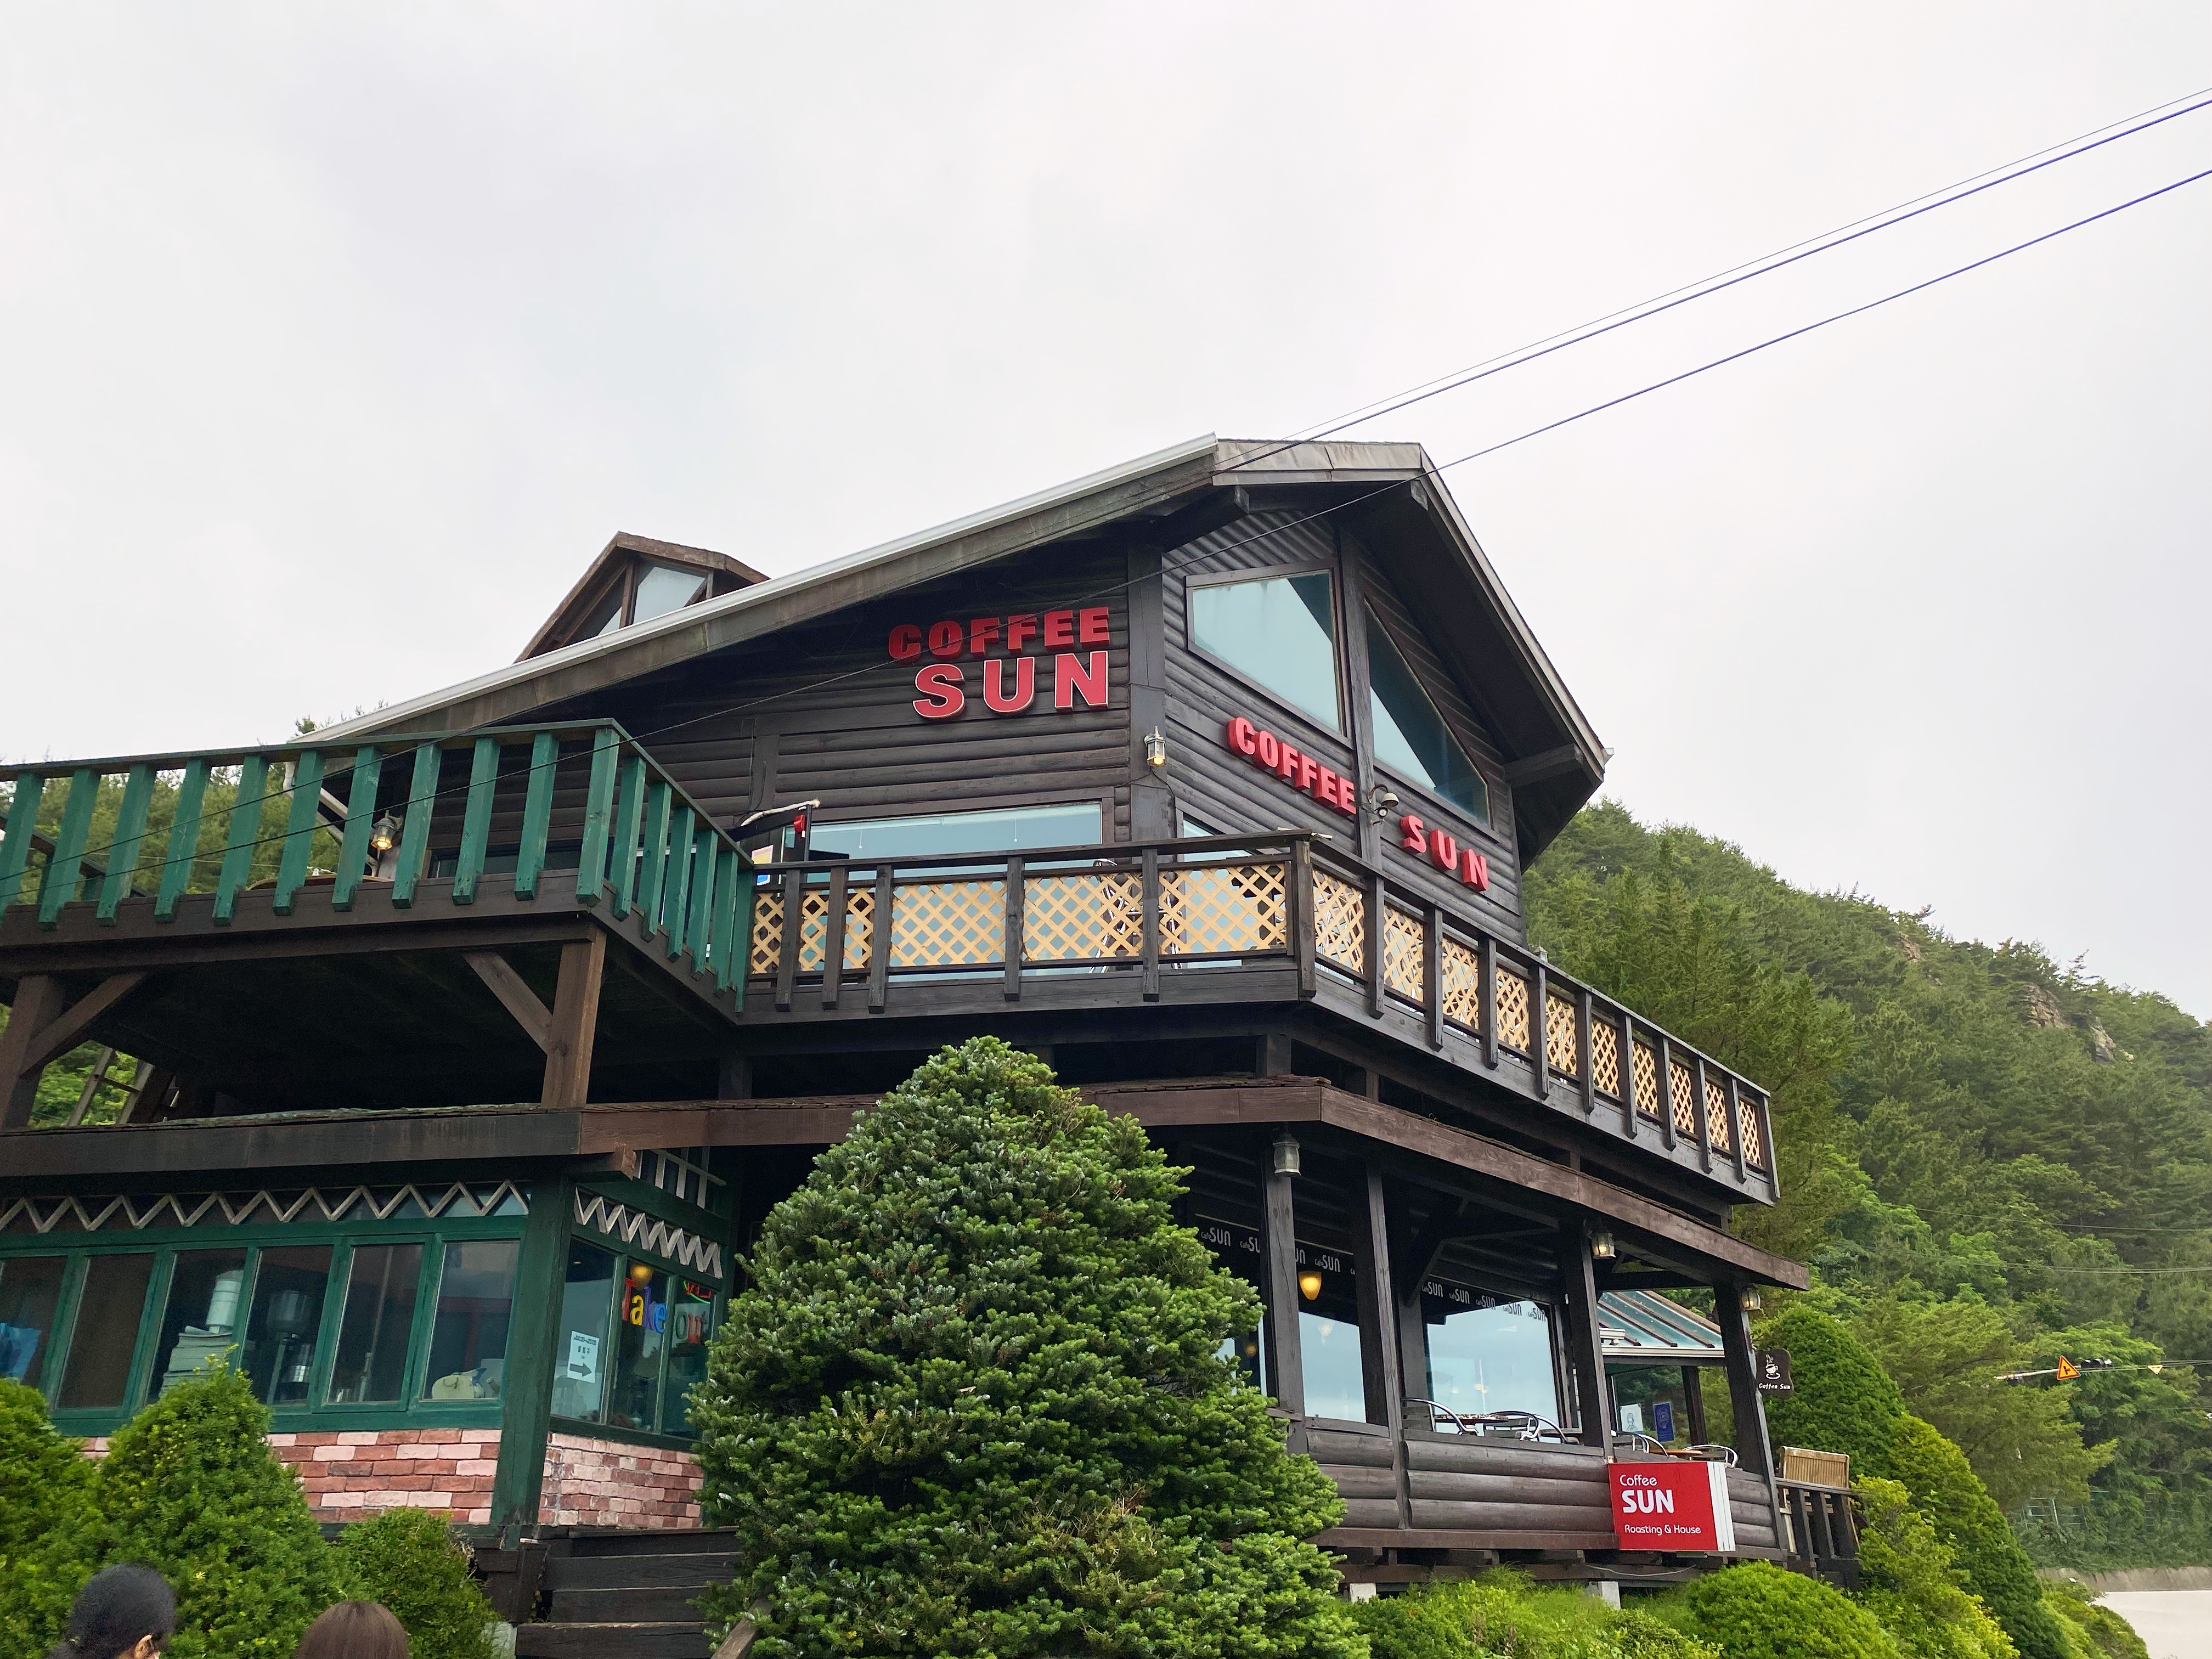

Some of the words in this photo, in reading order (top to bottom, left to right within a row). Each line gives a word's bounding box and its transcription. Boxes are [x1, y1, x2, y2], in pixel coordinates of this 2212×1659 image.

[888, 606, 1110, 665] COFFEE
[912, 650, 1109, 721] SUN
[1227, 716, 1357, 818] COFFEE
[1400, 814, 1489, 892] SUN
[622, 1277, 667, 1334] Take
[1620, 1474, 1657, 1486] Coffee
[1622, 1489, 1674, 1514] SUN
[1624, 1524, 1662, 1536] Roasting
[1664, 1525, 1672, 1533] &
[1674, 1525, 1701, 1534] House
